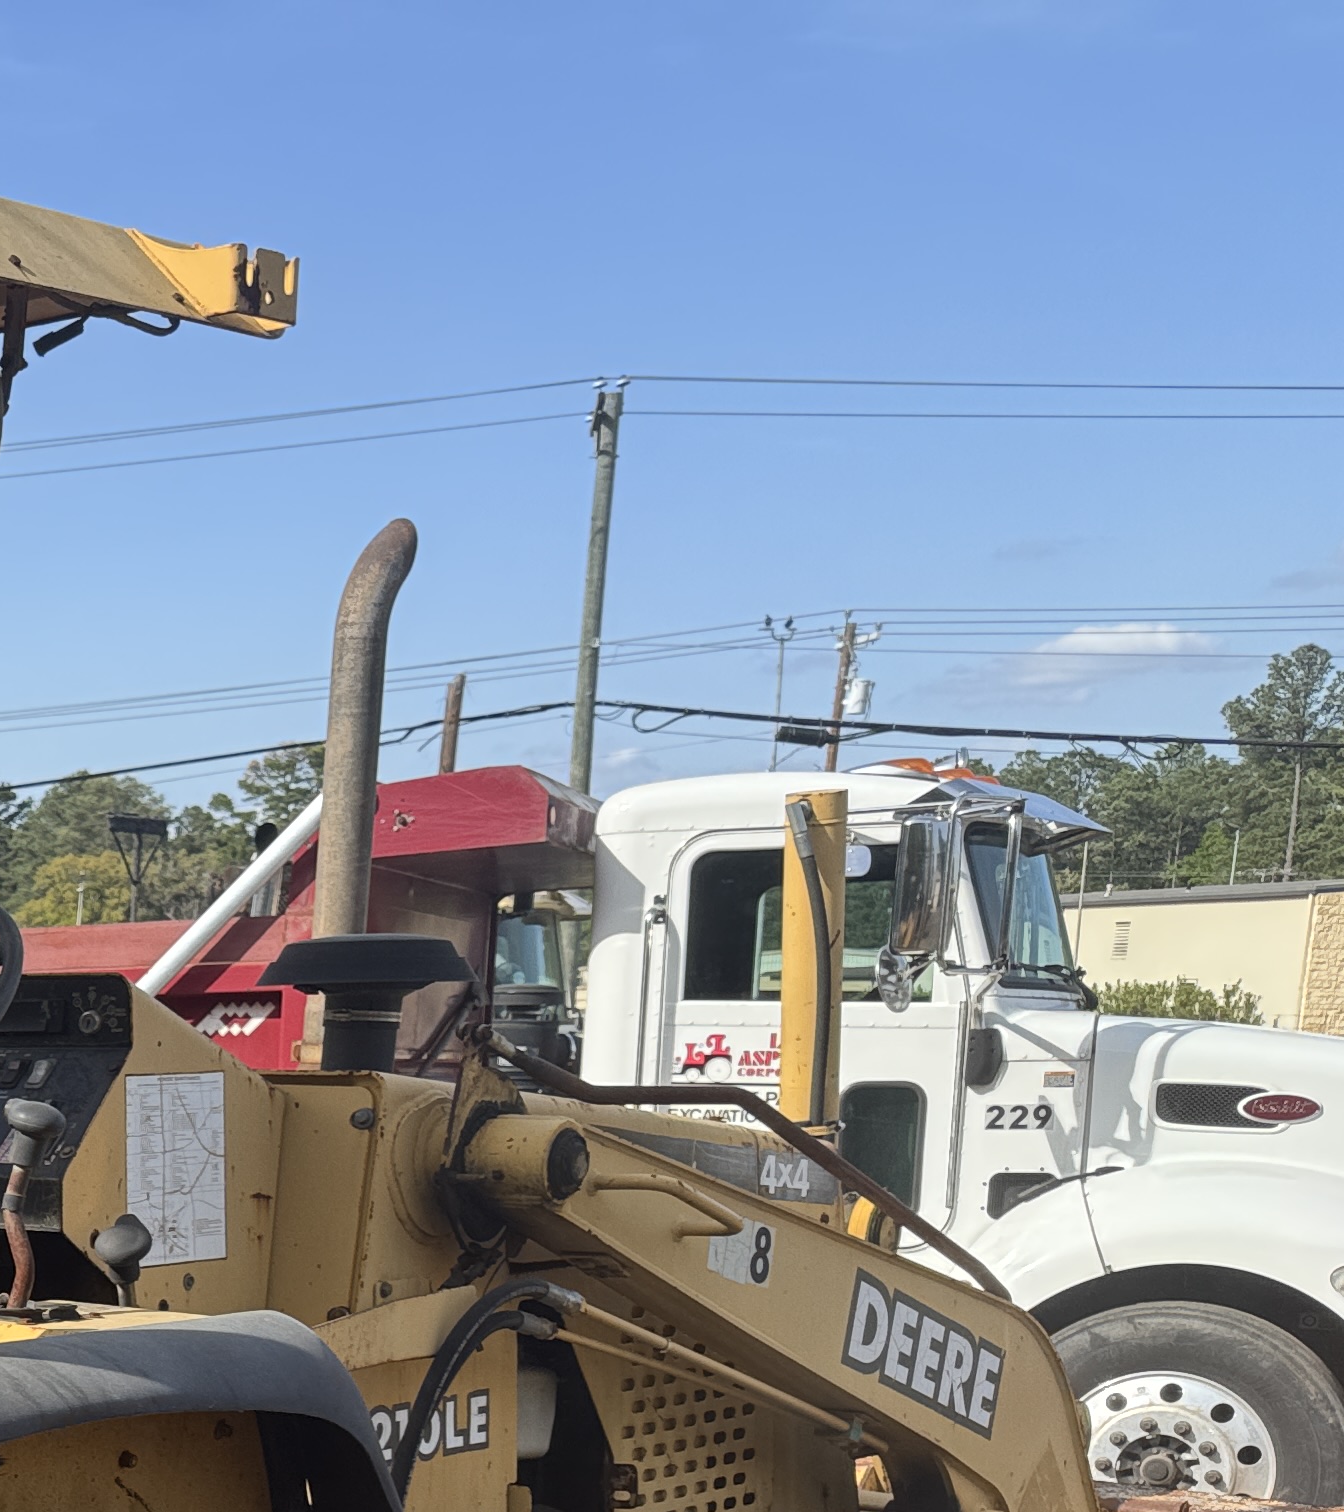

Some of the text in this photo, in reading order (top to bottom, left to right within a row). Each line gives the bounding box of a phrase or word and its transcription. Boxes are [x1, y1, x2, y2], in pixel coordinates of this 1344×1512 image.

[737, 1050, 782, 1067] ASP
[985, 1104, 1053, 1130] 229
[760, 1154, 810, 1198] 4x4
[847, 1279, 1003, 1430] DEERE
